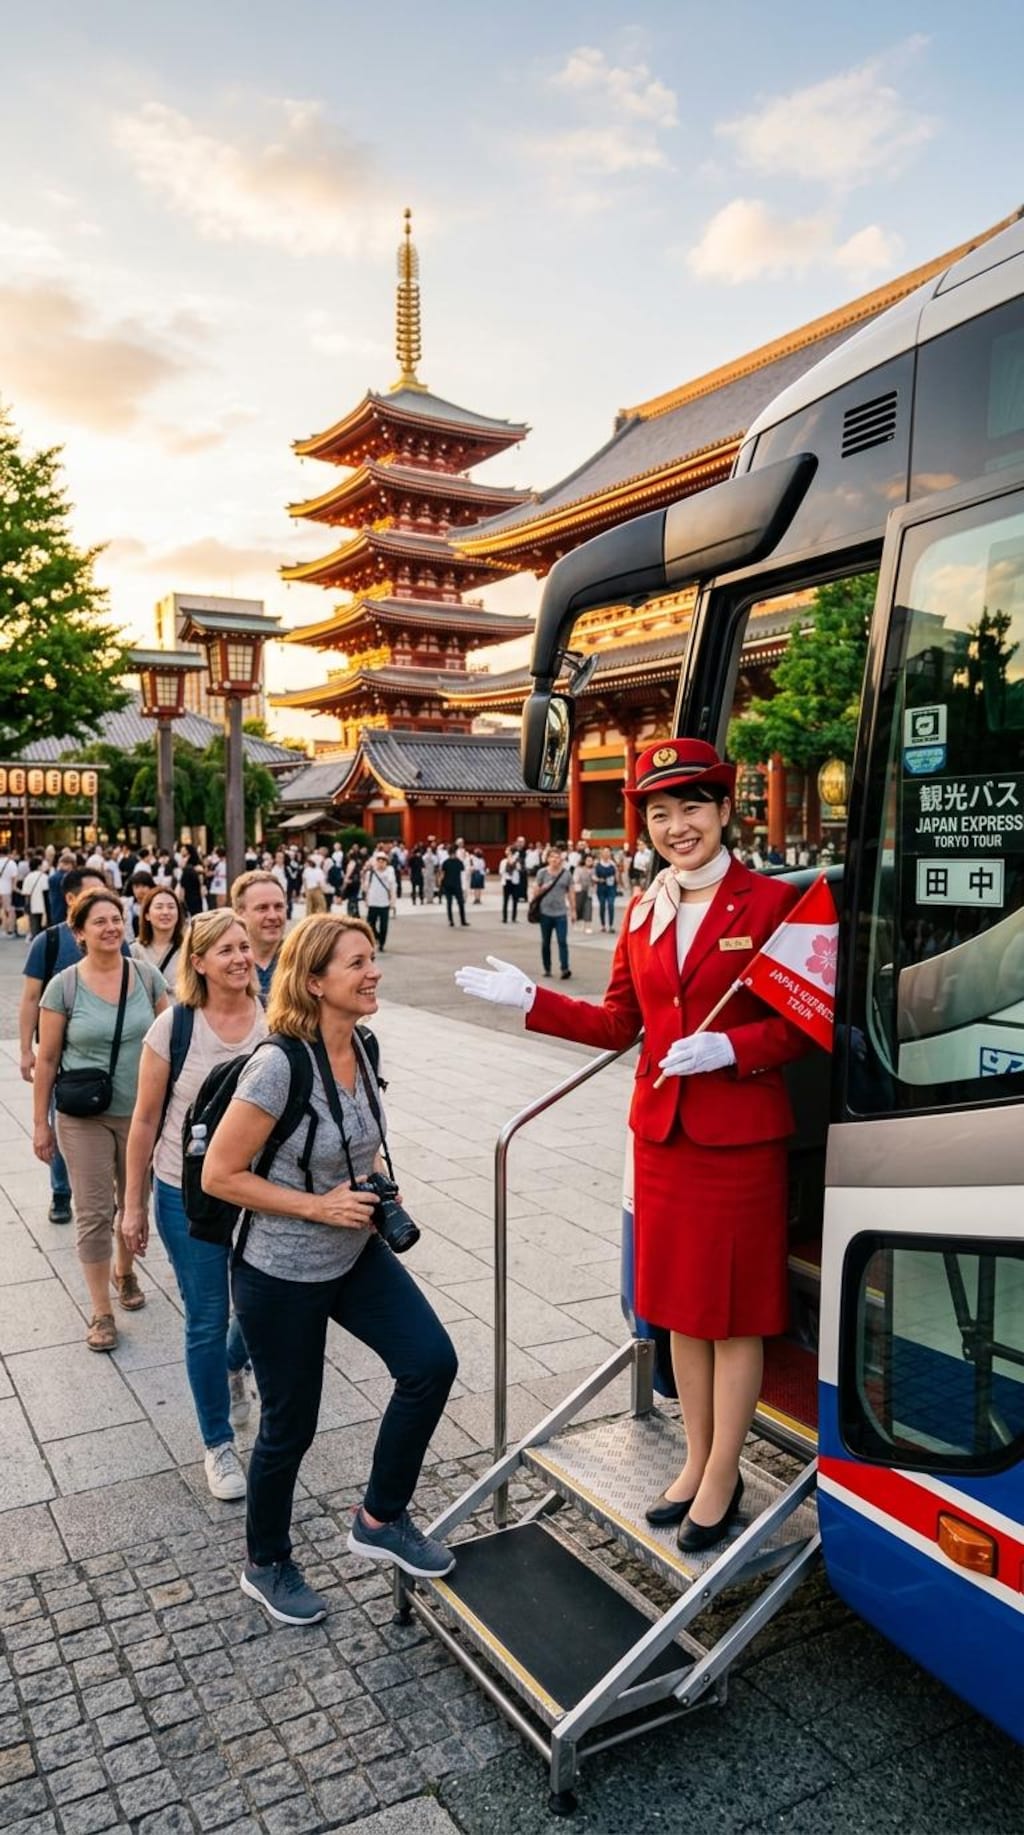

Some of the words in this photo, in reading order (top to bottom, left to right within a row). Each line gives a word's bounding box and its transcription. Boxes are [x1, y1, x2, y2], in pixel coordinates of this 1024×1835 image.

[920, 781, 1019, 812] 観光バス
[915, 817, 957, 833] JAPAN
[961, 815, 1023, 831] EXPRESS
[972, 835, 1002, 847] TOUR
[926, 867, 993, 899] 田中
